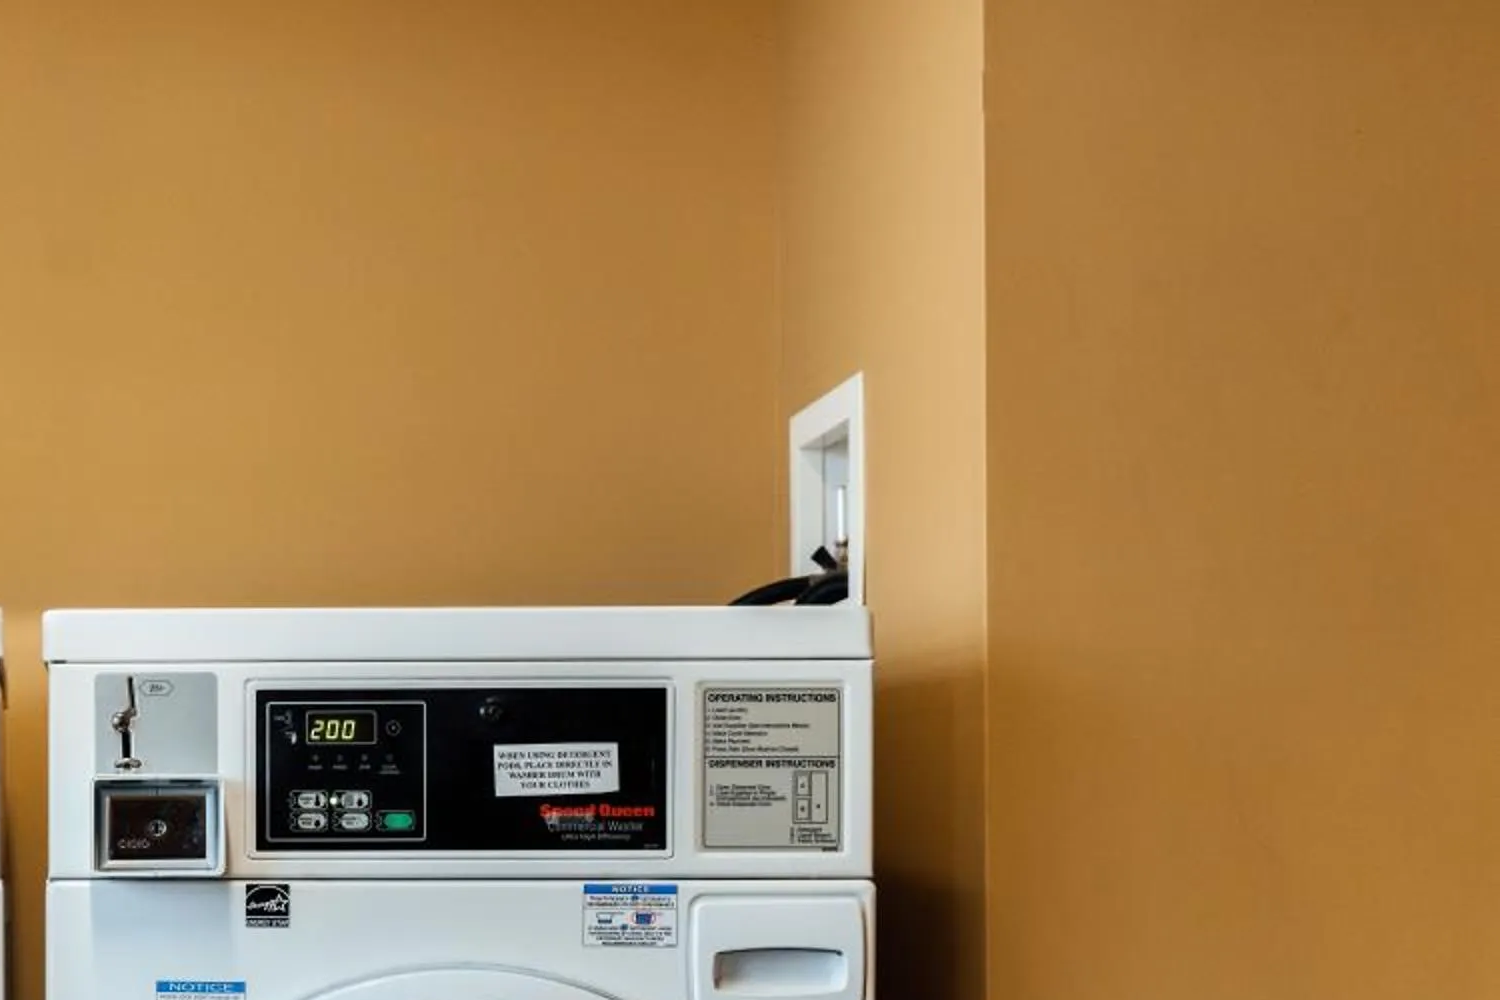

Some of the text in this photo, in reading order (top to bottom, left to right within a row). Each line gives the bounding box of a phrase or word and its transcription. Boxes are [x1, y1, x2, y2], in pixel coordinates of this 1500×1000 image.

[707, 693, 837, 703] OPERATING INSTRUCTIONS
[309, 719, 357, 740] 200
[497, 750, 611, 760] WHEN USING DETERGENT
[524, 761, 552, 769] PLACE
[555, 760, 601, 769] DIRECTLY
[707, 759, 837, 769] DISPENSER INSTRUCTIONS
[577, 770, 601, 778] WITH
[520, 780, 591, 789] YOUR CLOTHES
[599, 803, 656, 817] Queen
[607, 819, 644, 832] Washer
[611, 885, 649, 893] NOTICE
[169, 983, 231, 992] NOTICE
